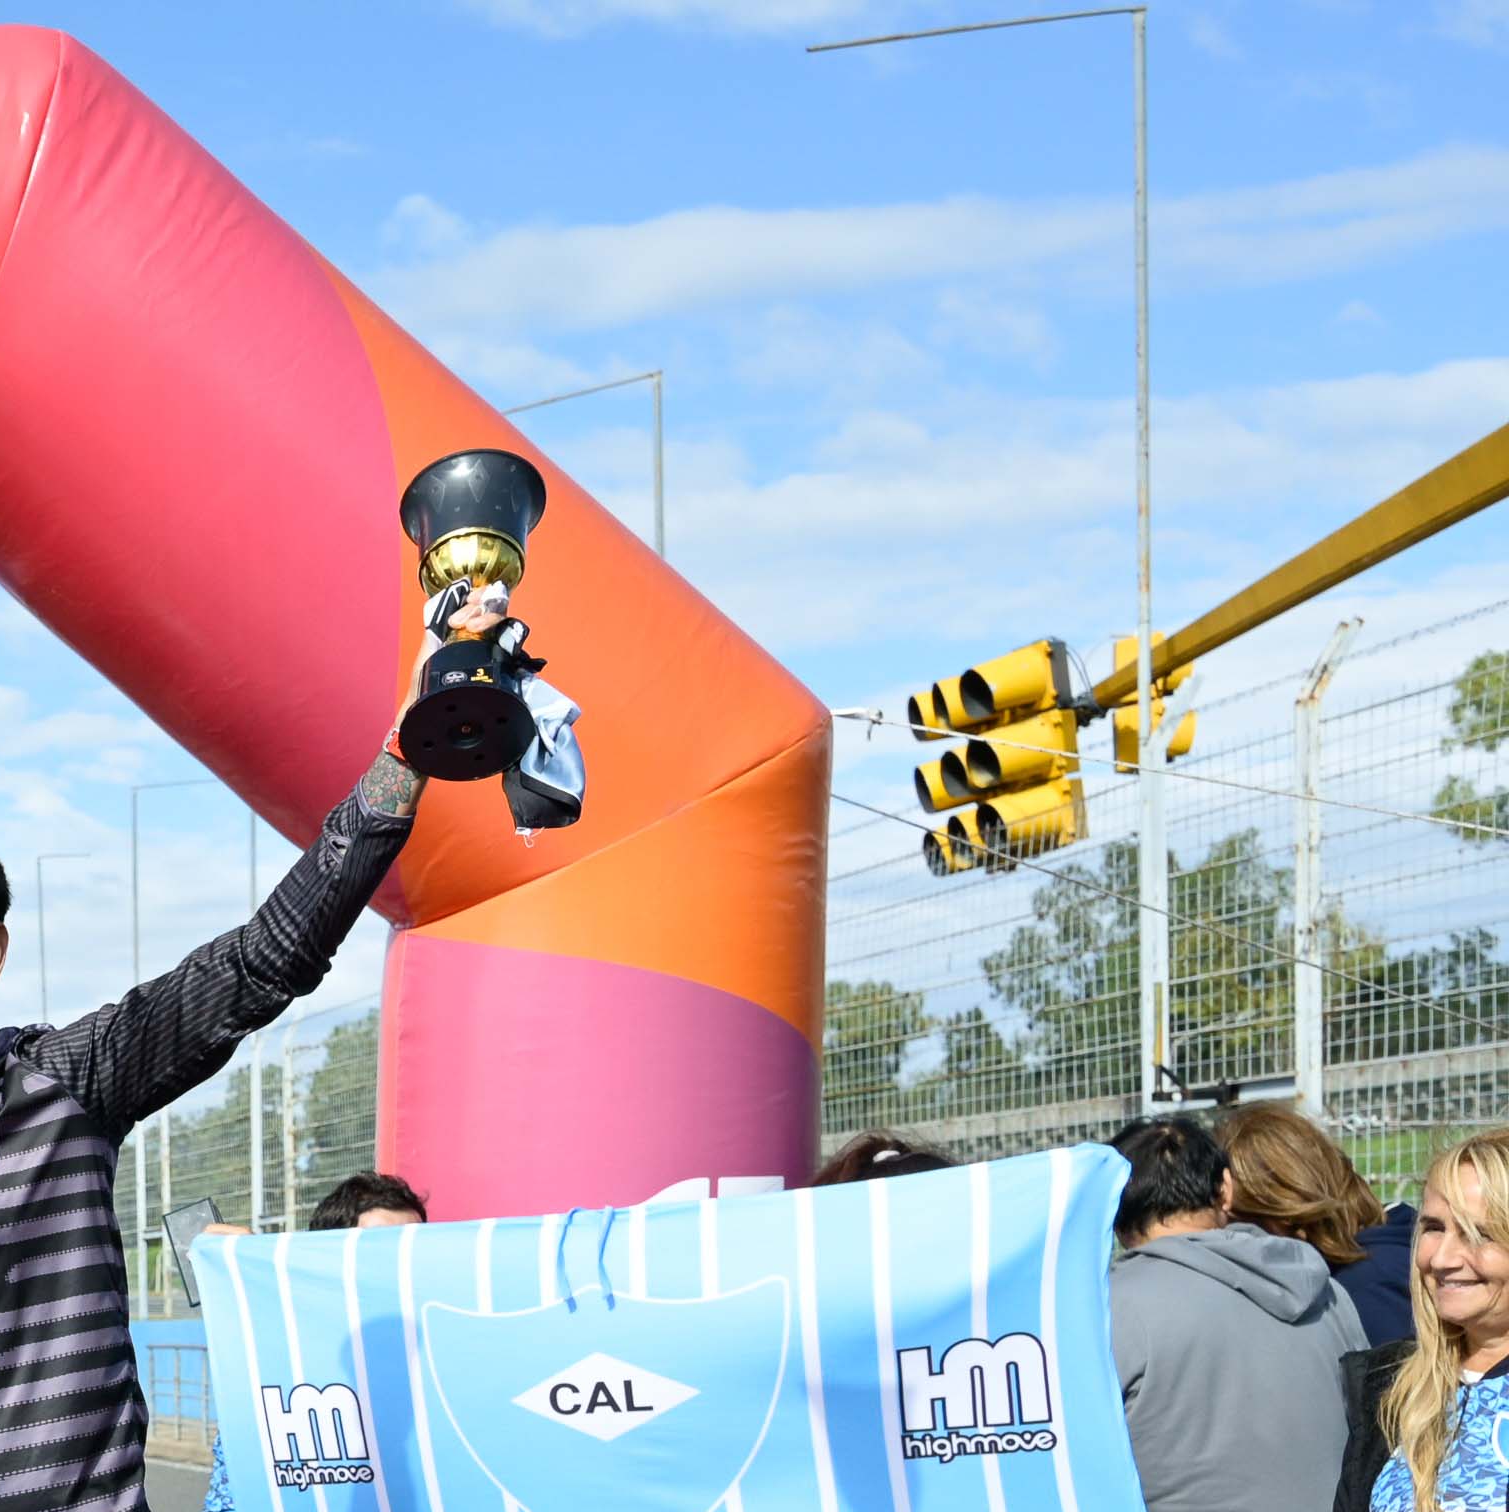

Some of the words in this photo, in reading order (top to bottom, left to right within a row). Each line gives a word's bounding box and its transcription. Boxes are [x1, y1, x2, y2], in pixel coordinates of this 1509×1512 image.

[549, 1379, 654, 1415] CAL
[902, 1429, 1058, 1464] highmove
[274, 1463, 374, 1491] highmove
